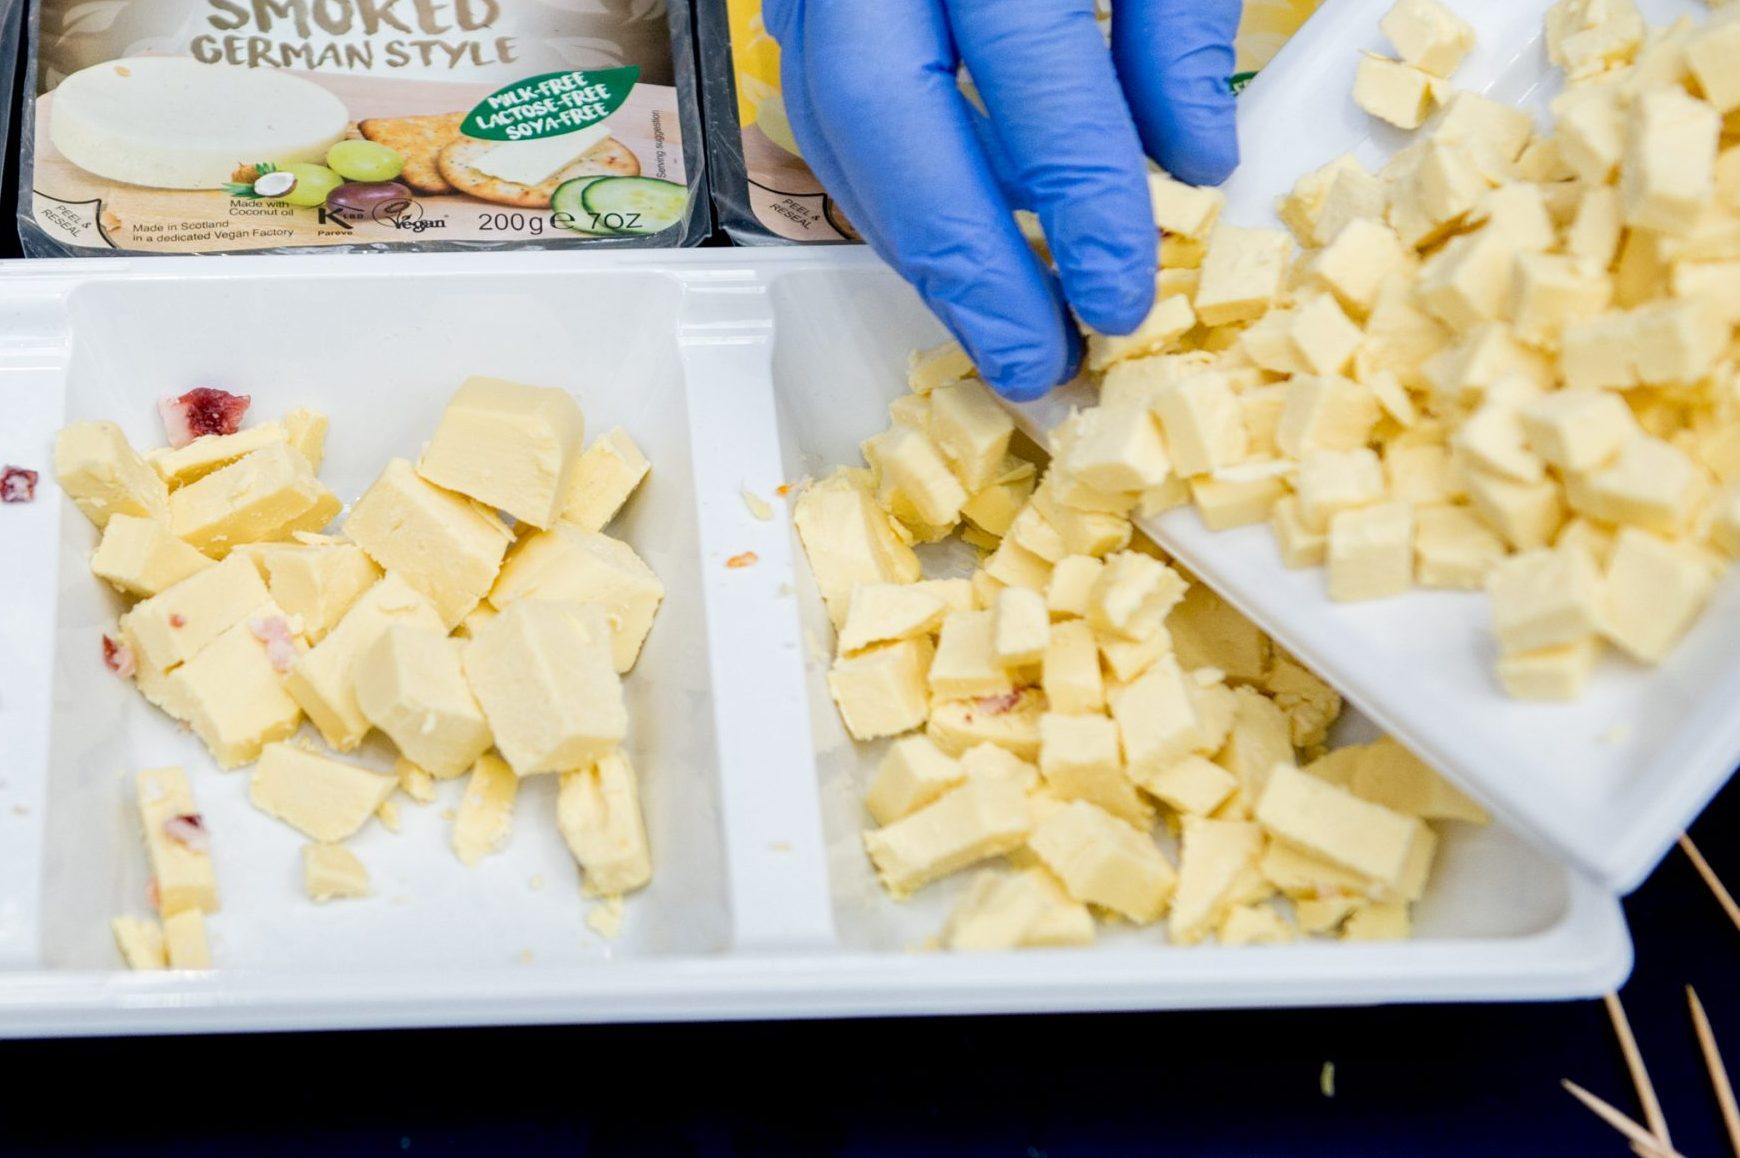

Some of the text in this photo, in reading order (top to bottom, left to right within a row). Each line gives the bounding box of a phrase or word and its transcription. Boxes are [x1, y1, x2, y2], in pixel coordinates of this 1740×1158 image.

[207, 0, 501, 39] SMOKED
[190, 34, 519, 70] GERMAN STYLE
[487, 71, 589, 110] MILK-FREE
[475, 83, 612, 130] LACTOSE-FREE
[505, 102, 610, 141] SOYA-FREE
[651, 110, 668, 179] Serving suggestion
[56, 204, 81, 225] PEEL
[229, 200, 290, 208] Made with
[229, 207, 294, 217] Coconut oil
[782, 198, 811, 217] PEEL
[41, 208, 81, 238] RESEAL
[132, 220, 229, 233] Made in Scotland
[385, 215, 446, 233] Vegan
[478, 213, 544, 235] 200g
[769, 203, 812, 230] RESEAL
[132, 234, 144, 243] in
[156, 231, 211, 243] dedicated
[214, 230, 250, 241] Vegan
[252, 227, 295, 239] Factory
